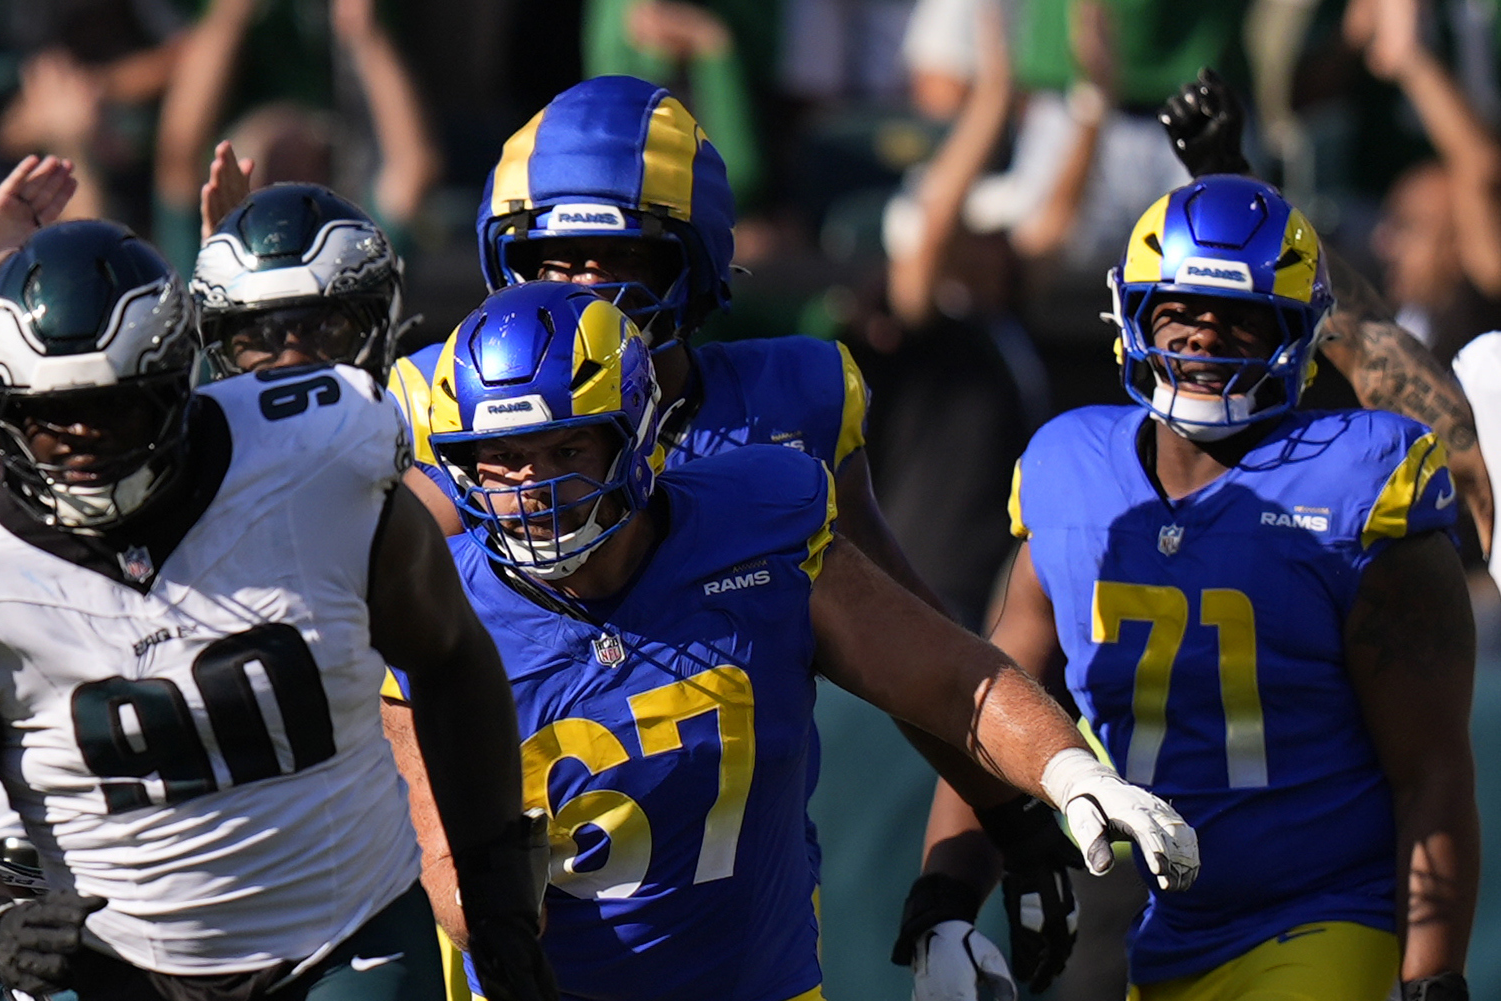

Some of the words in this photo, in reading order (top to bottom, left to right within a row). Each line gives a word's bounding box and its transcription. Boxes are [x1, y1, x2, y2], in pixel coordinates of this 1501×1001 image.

[558, 212, 620, 226] RAMS
[1187, 265, 1248, 283] RAMS
[487, 400, 534, 415] RAMS
[1260, 511, 1329, 532] RAMS
[702, 569, 772, 597] RAMS
[1091, 579, 1269, 789] 71
[70, 621, 338, 815] 90
[520, 663, 756, 900] 67
